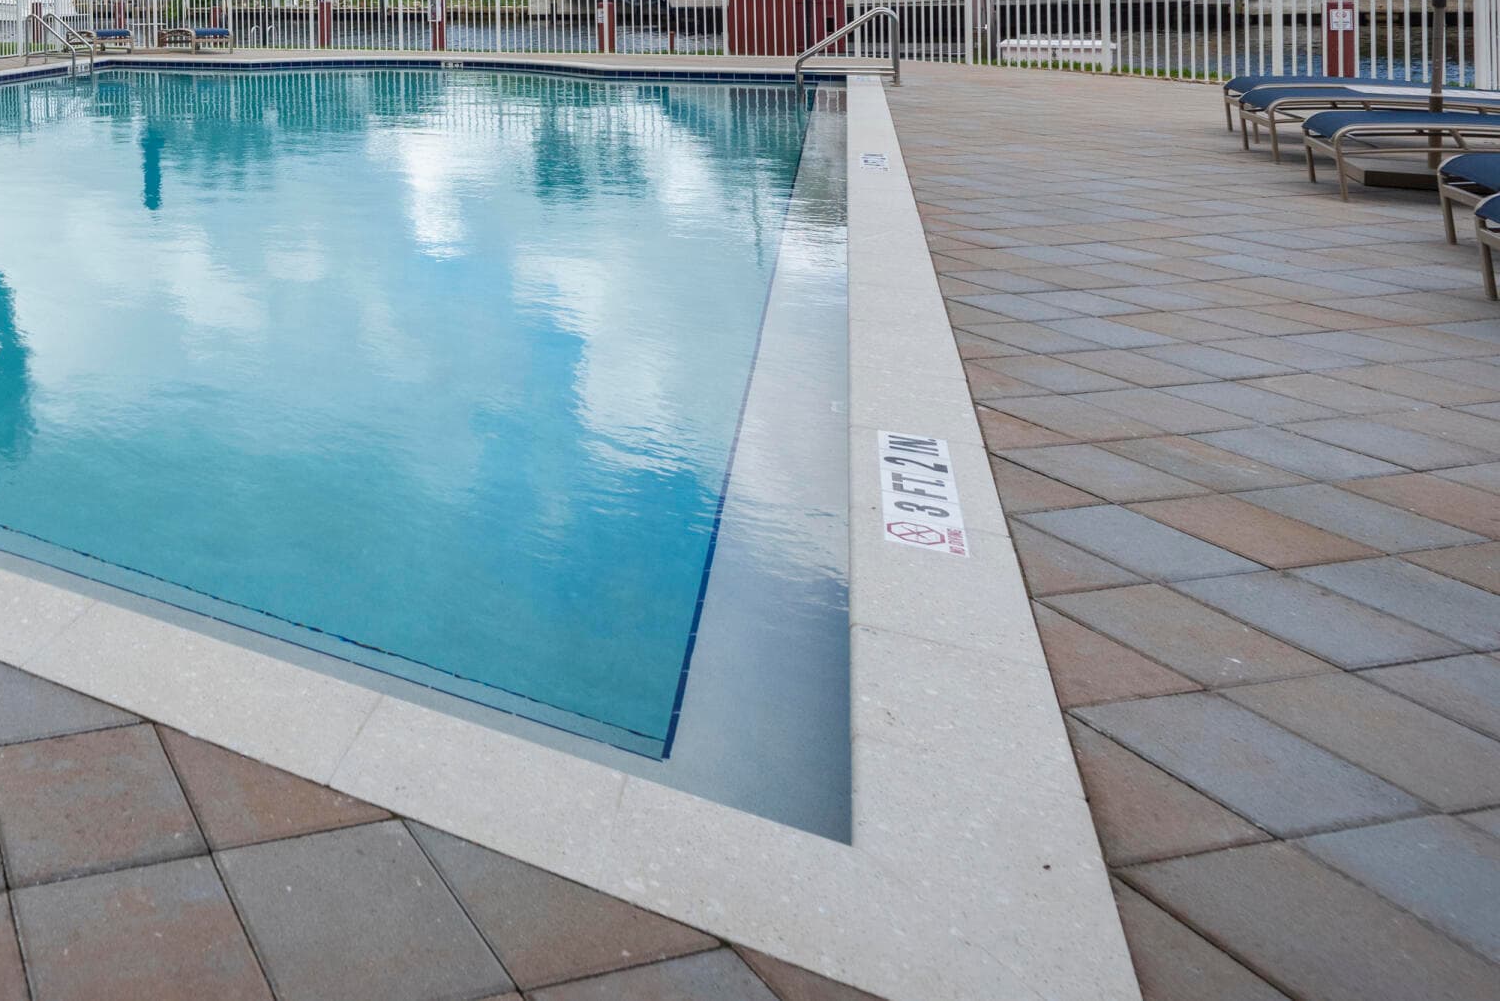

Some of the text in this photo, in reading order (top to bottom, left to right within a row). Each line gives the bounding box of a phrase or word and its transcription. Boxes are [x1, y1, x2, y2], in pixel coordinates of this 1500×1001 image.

[883, 456, 949, 474] 2
[891, 472, 948, 501] FT.
[894, 500, 950, 518] 3
